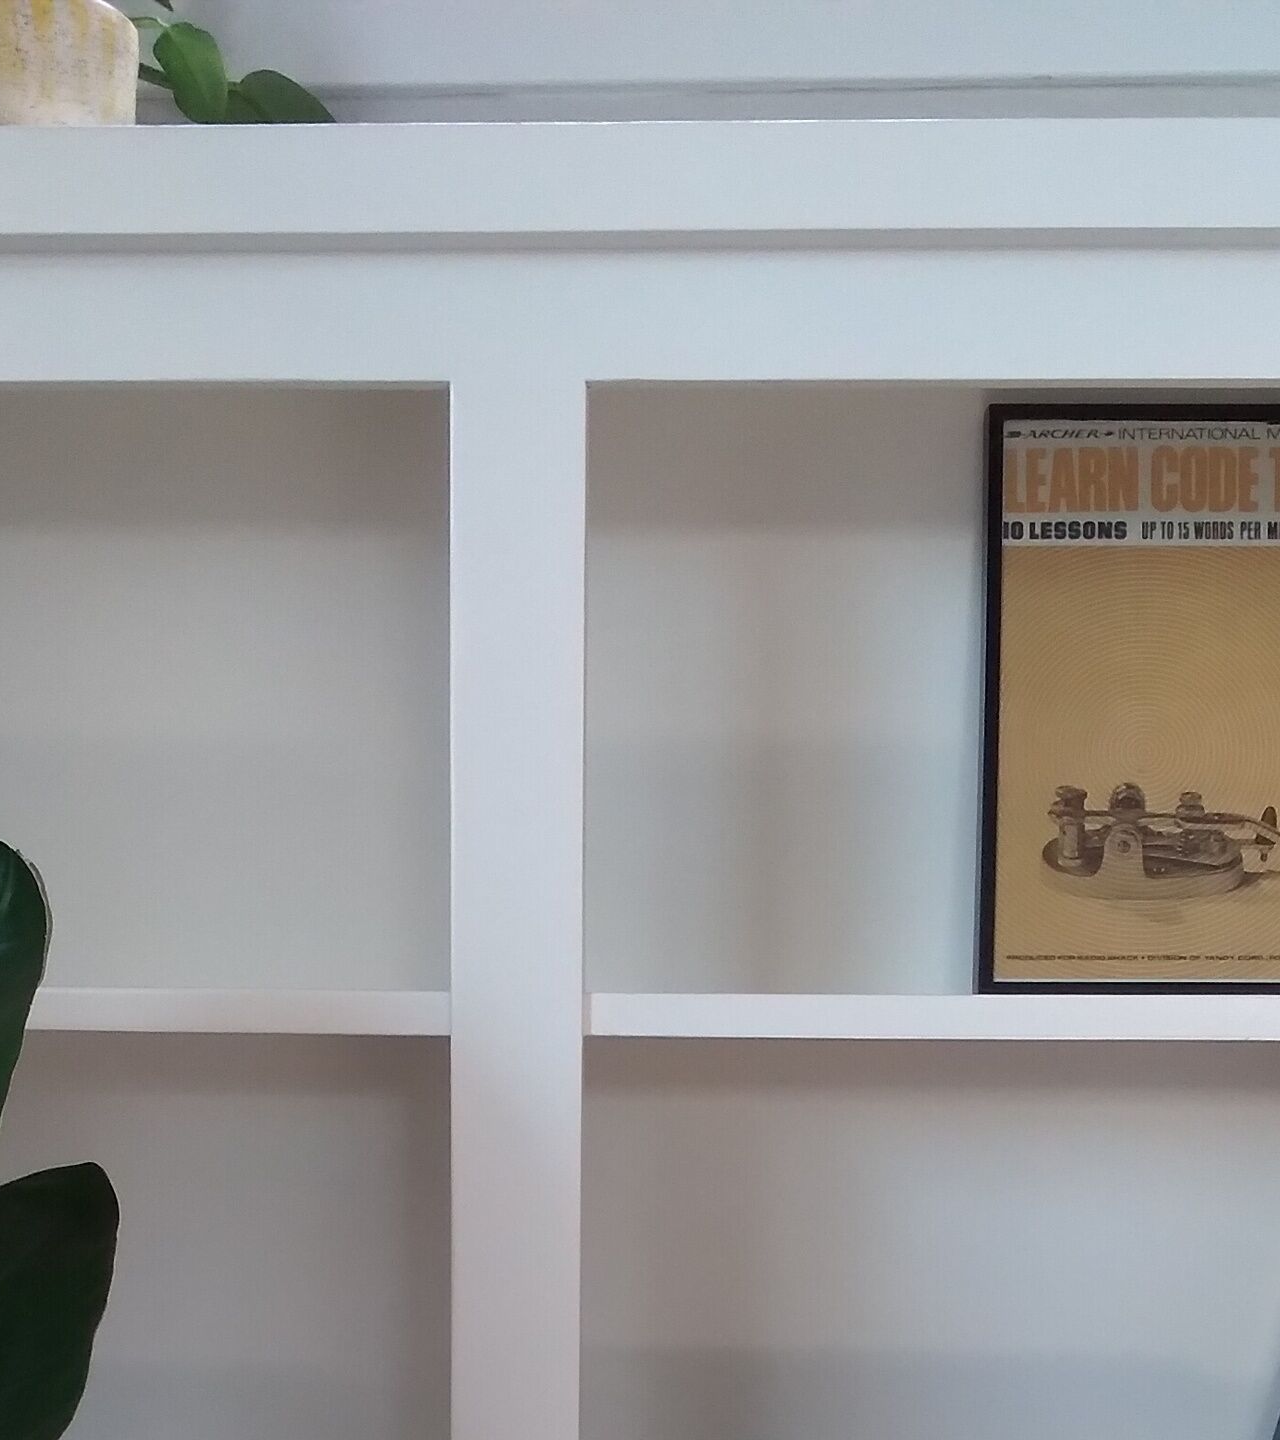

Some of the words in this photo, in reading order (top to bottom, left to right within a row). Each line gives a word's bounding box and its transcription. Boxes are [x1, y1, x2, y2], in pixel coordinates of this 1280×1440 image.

[1024, 428, 1099, 439] ARCHER
[1119, 427, 1261, 441] INTERNATIONAL
[1004, 446, 1140, 513] LEARN
[1151, 445, 1260, 513] CODE
[1003, 521, 1025, 540] 10
[1028, 520, 1128, 540] LESSONS
[1141, 521, 1155, 540] UP
[1160, 521, 1174, 540] TO
[1177, 521, 1190, 540] 15
[1194, 521, 1235, 540] WORDS
[1239, 521, 1262, 540] PER
